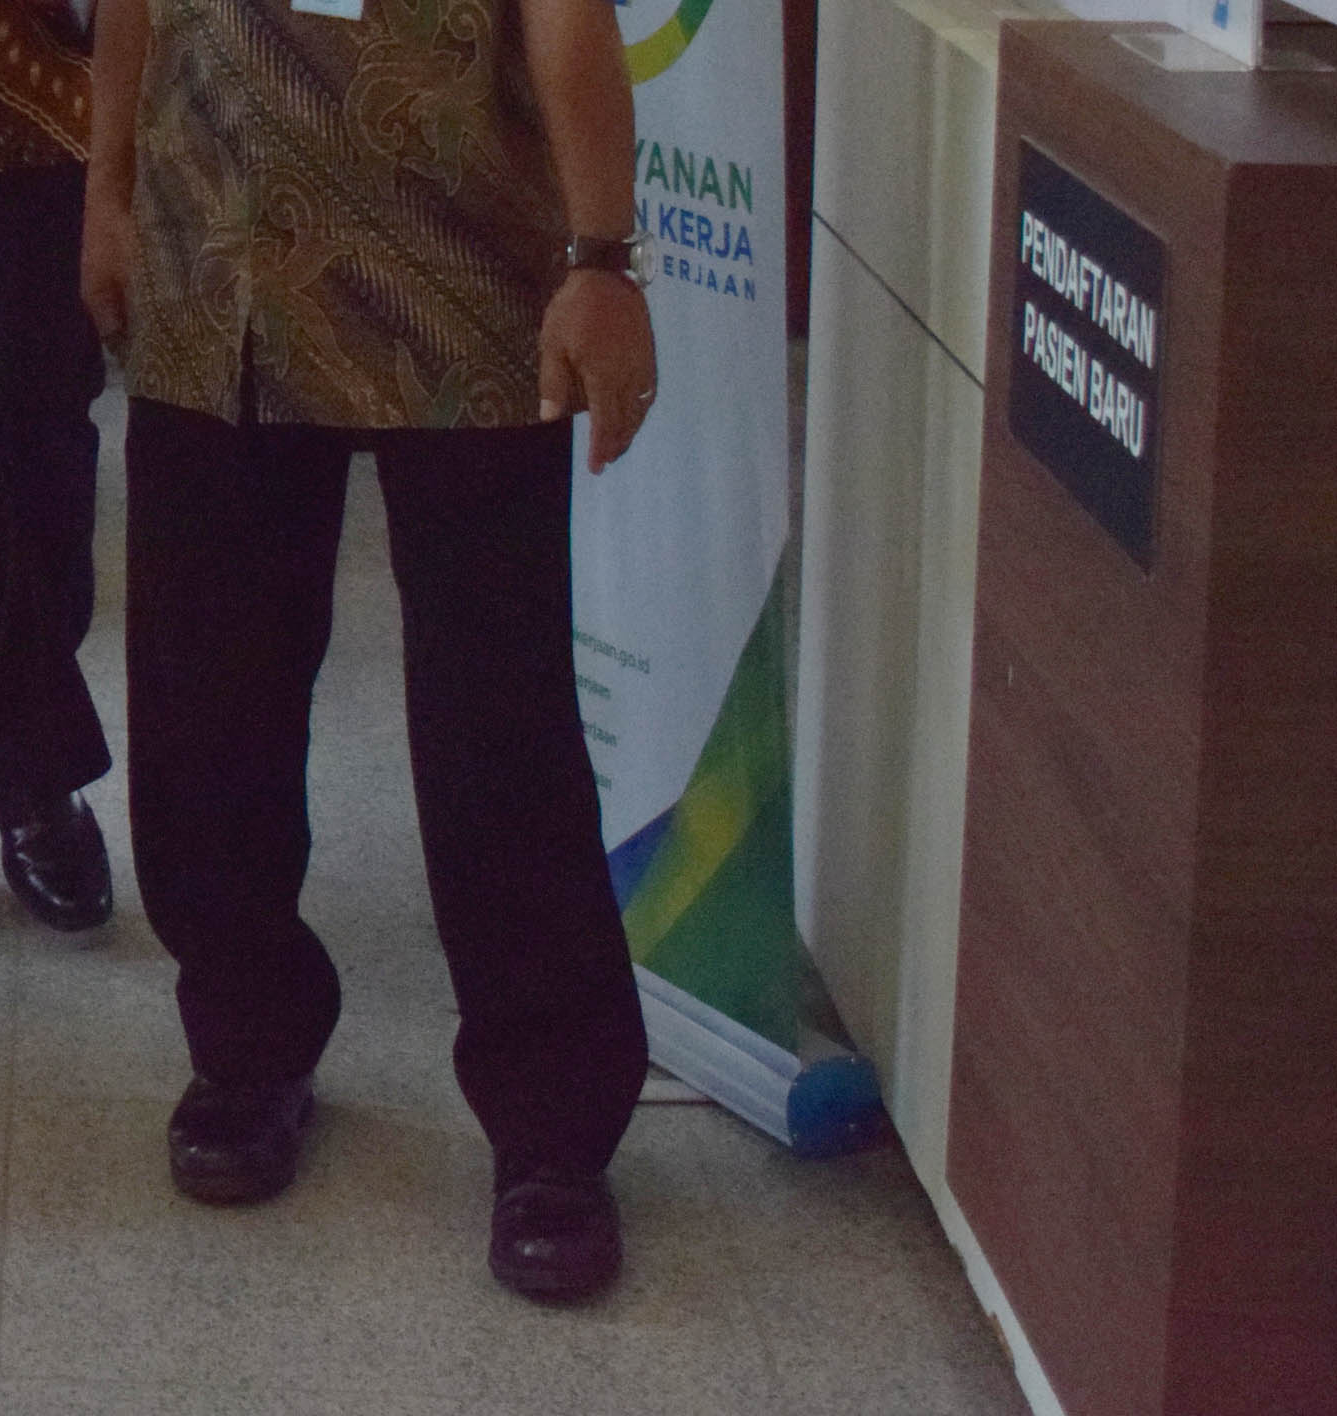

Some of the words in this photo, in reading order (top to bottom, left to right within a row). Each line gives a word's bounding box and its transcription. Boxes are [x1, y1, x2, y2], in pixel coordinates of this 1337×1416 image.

[658, 201, 754, 267] KERJA
[661, 253, 756, 302] ERJAAN
[1021, 210, 1156, 369] PENDAFTARAN
[1022, 300, 1087, 407] PASIEN
[1088, 357, 1145, 459] BARU
